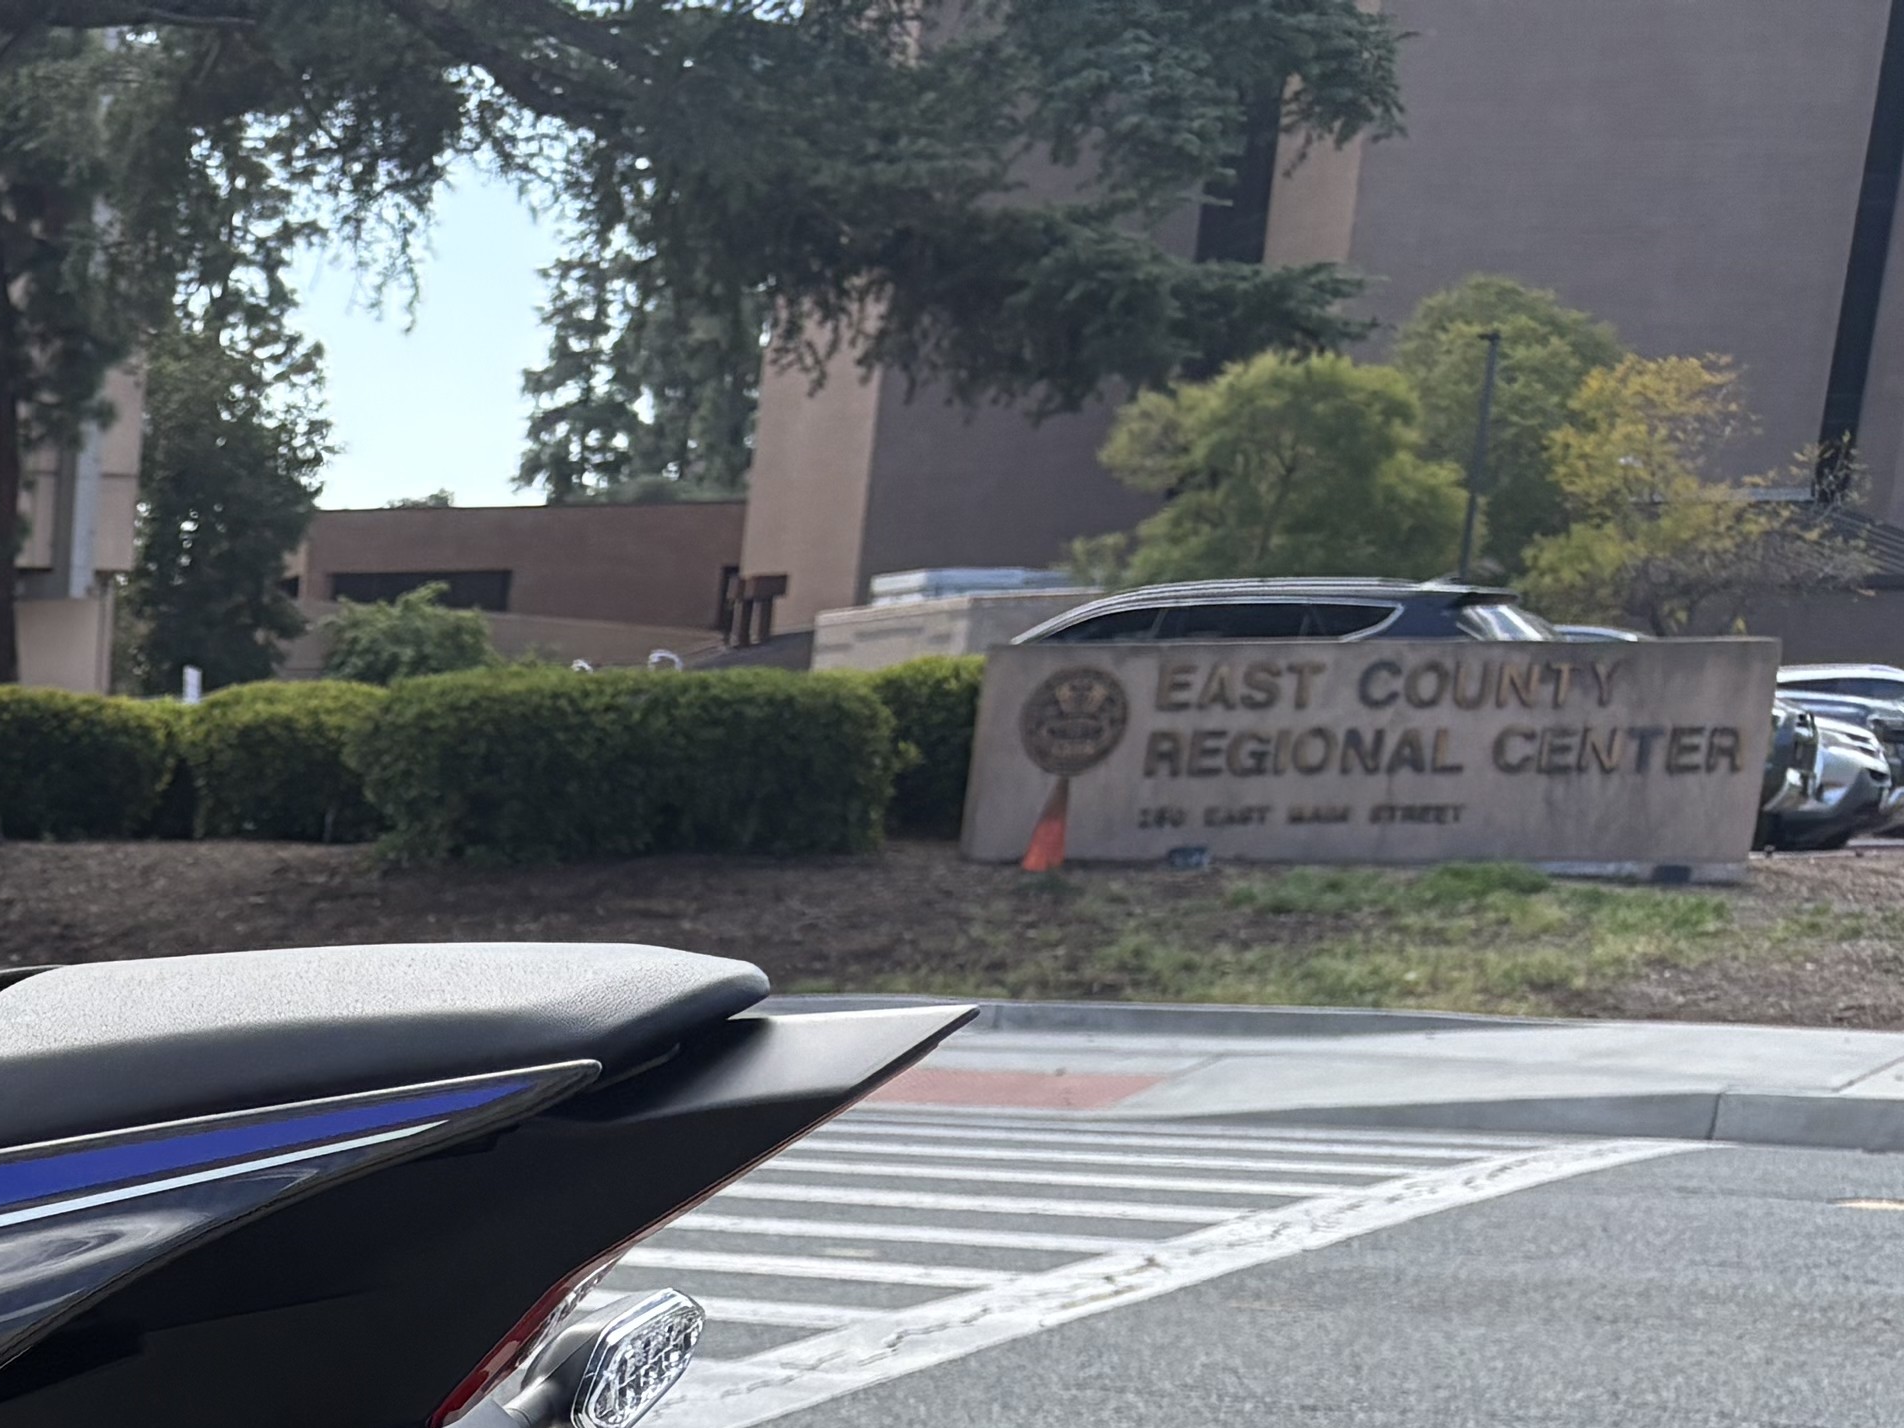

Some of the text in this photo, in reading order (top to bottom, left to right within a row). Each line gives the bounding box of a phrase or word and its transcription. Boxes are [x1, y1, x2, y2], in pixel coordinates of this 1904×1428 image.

[1154, 659, 1624, 712] EAST COUNTY
[1142, 726, 1743, 779] REGIONAL CENTER
[1203, 804, 1271, 827] EAST
[1369, 802, 1466, 825] STREET
